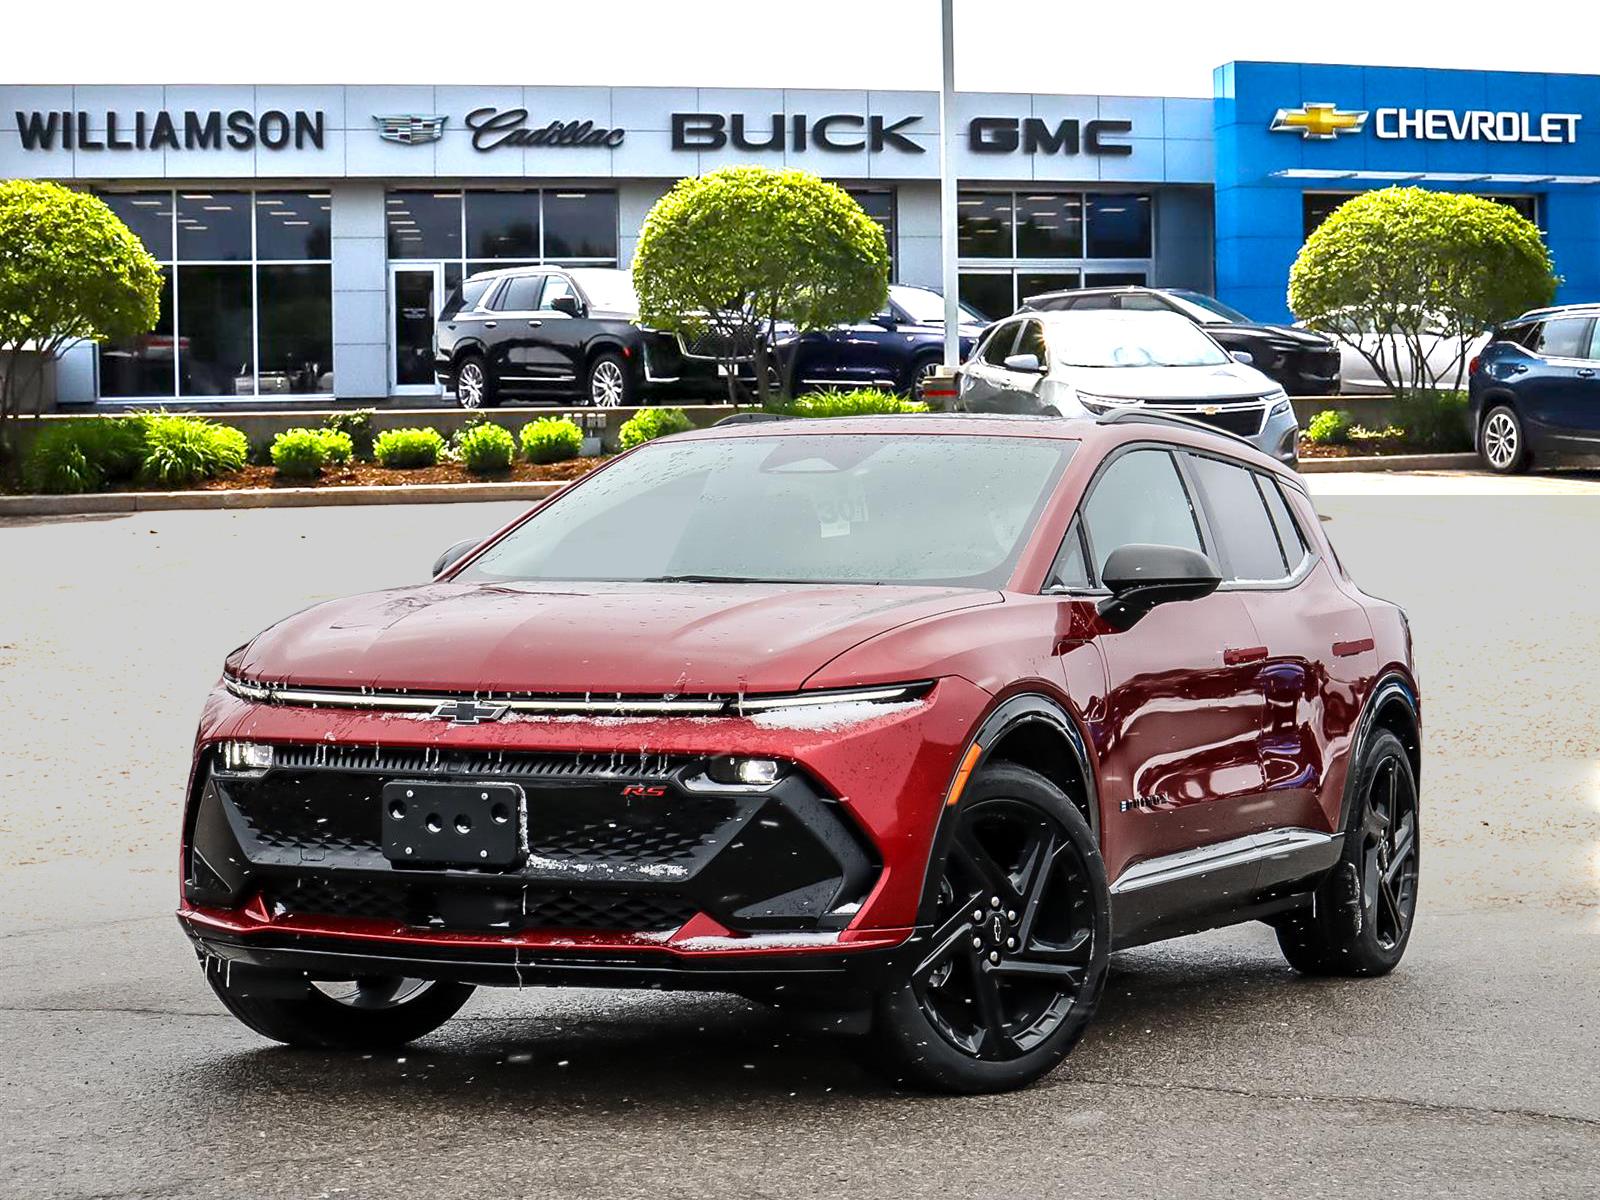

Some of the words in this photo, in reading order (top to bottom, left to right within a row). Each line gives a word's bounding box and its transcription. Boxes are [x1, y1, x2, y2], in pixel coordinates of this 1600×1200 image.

[16, 111, 324, 151] WILLIAMSON
[465, 108, 626, 153] Cadillac
[672, 114, 926, 154] BUICK
[970, 118, 1133, 156] GMC
[1376, 107, 1582, 143] CHEVROLET
[621, 784, 668, 797] RS
